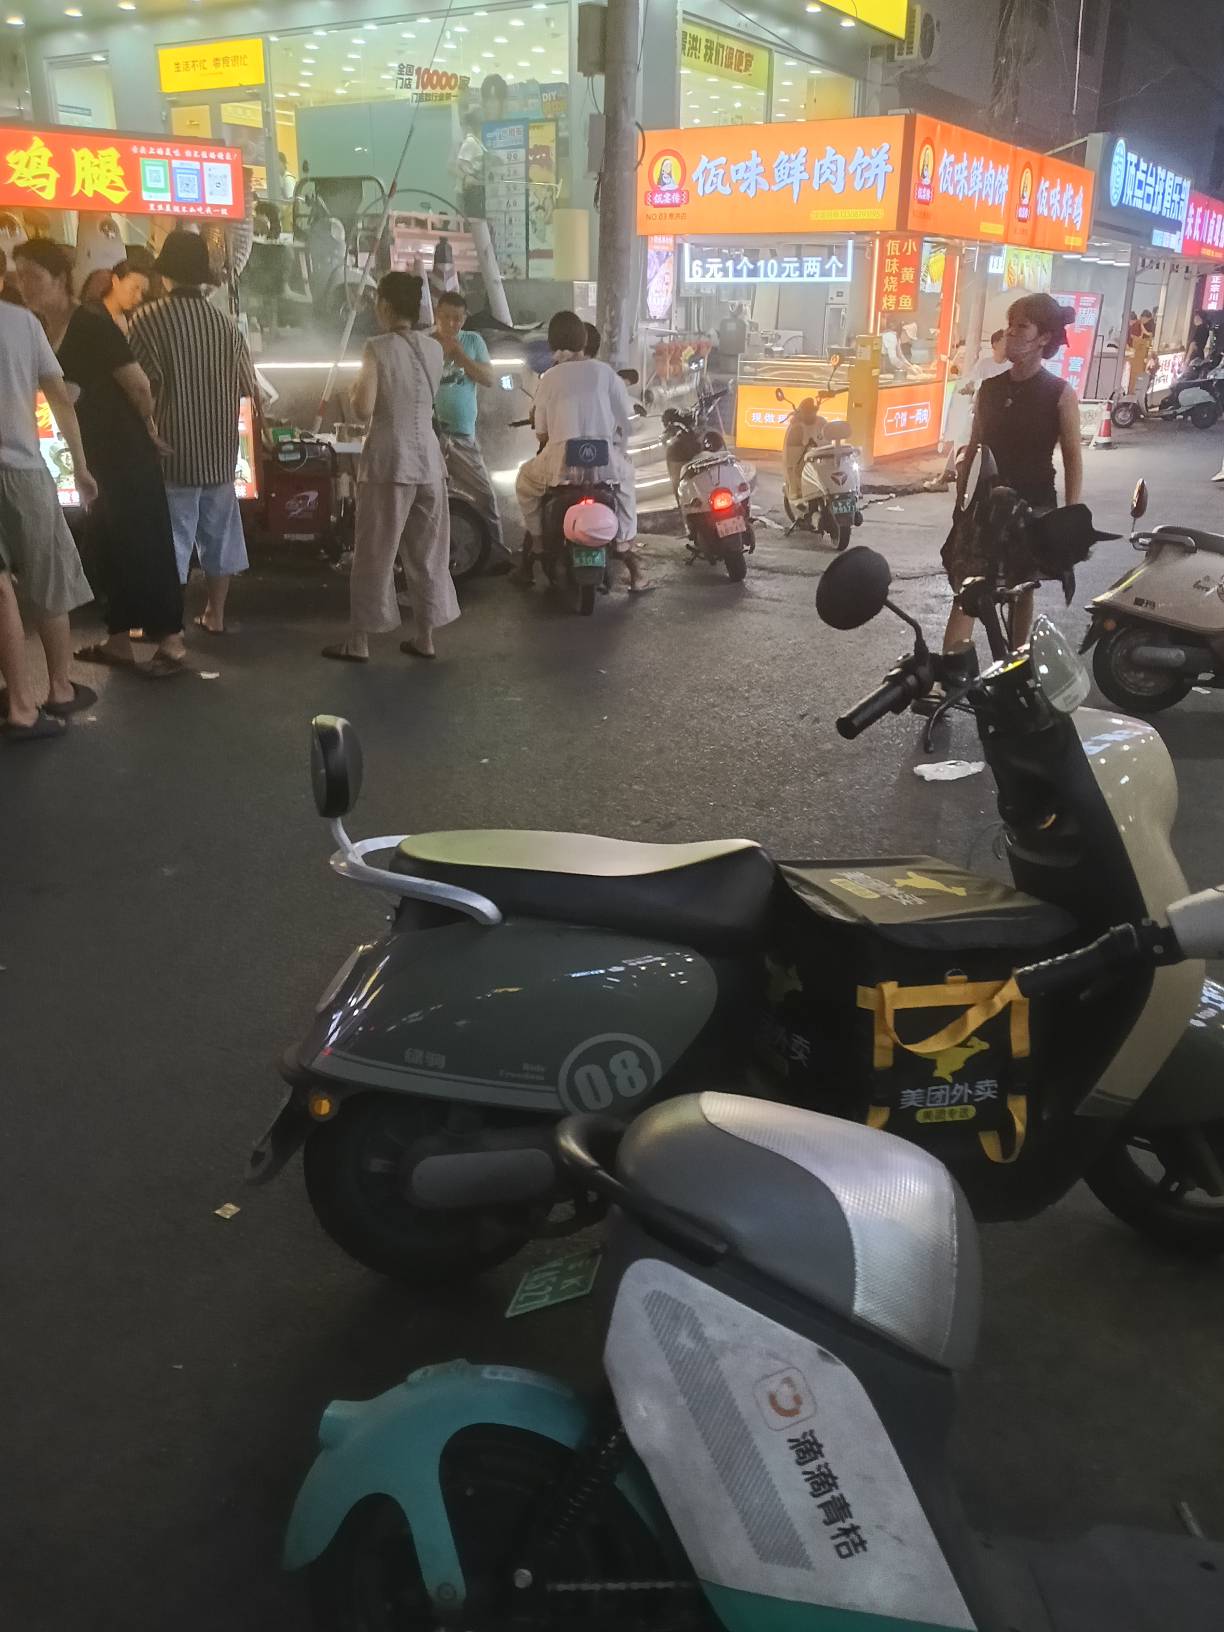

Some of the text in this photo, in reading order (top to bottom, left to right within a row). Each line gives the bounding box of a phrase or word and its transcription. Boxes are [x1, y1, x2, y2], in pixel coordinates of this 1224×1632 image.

[4, 136, 131, 204] 鸡腿
[692, 142, 894, 204] 佤味鲜肉饼
[691, 255, 844, 279] 6元1个10元两个
[882, 239, 901, 311] 佤味烧烤
[898, 239, 918, 310] 小黄鱼
[574, 1050, 648, 1110] 08
[899, 1079, 999, 1110] 美团外卖
[787, 1428, 869, 1560] 滴滴青桔
